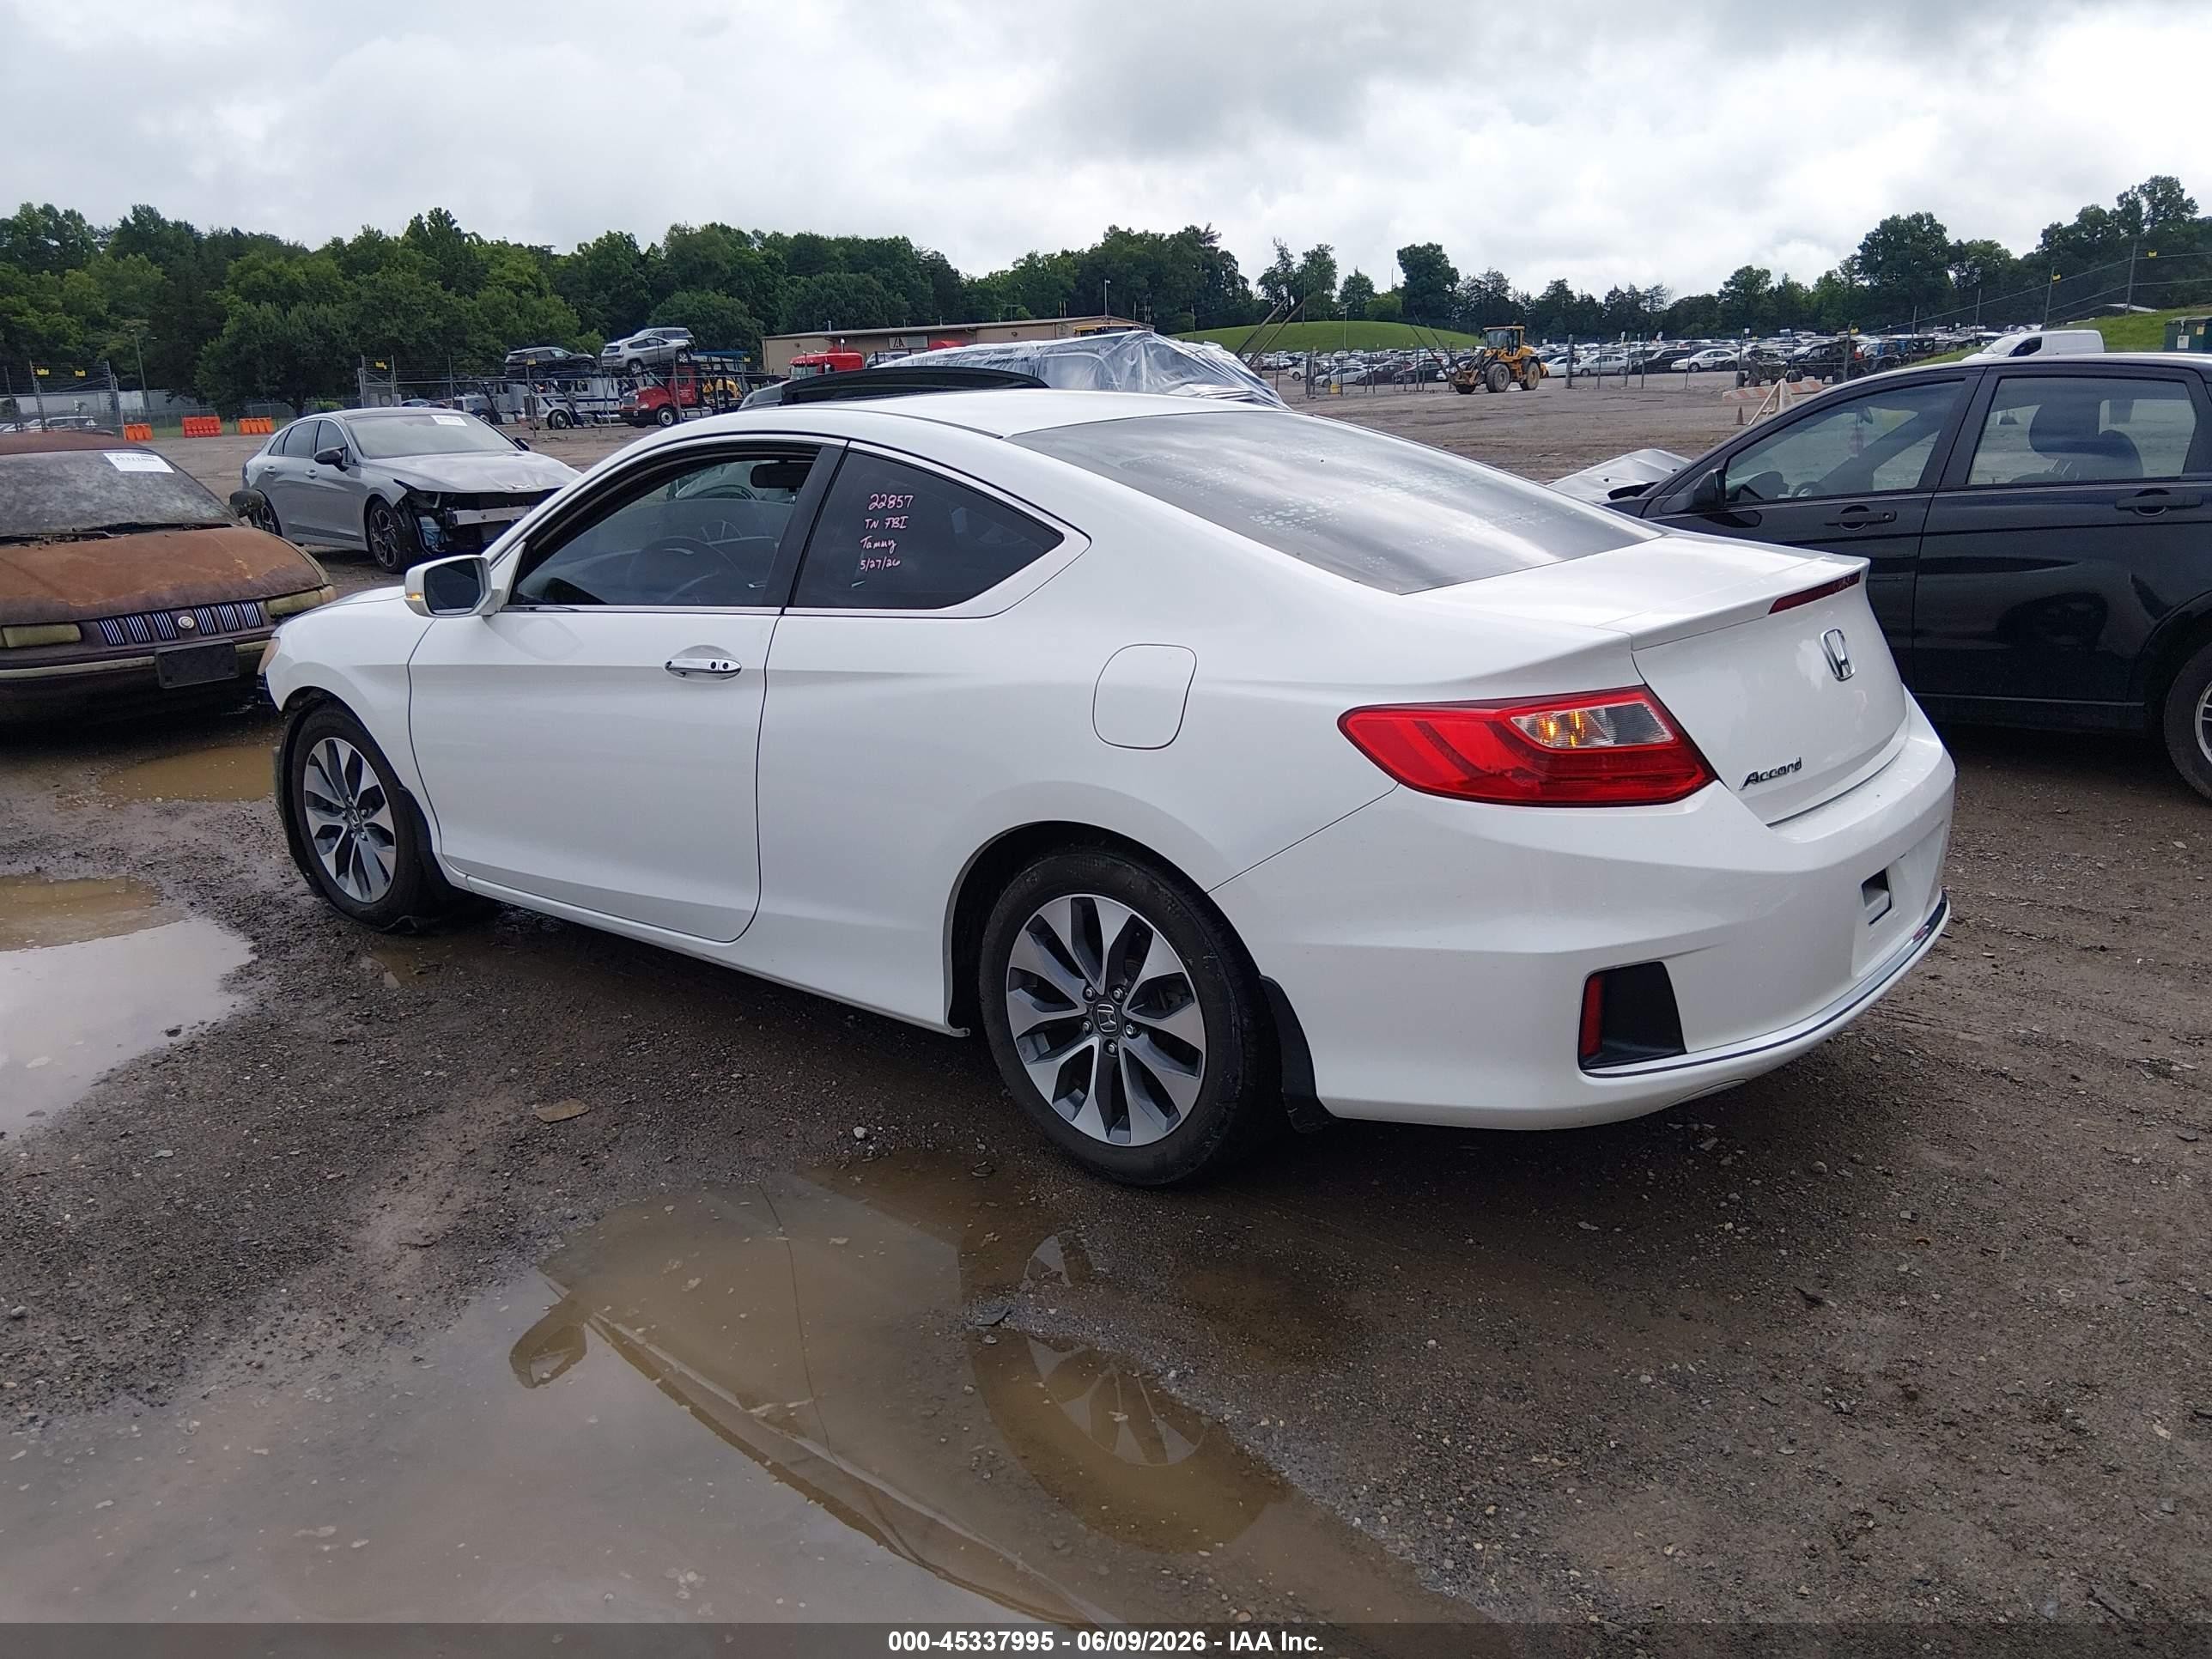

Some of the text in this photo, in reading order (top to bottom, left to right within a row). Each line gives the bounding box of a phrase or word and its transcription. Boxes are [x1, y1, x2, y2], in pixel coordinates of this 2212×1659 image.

[868, 493, 914, 511] 22857
[864, 518, 880, 530] TN
[1738, 756, 1802, 791] Accord
